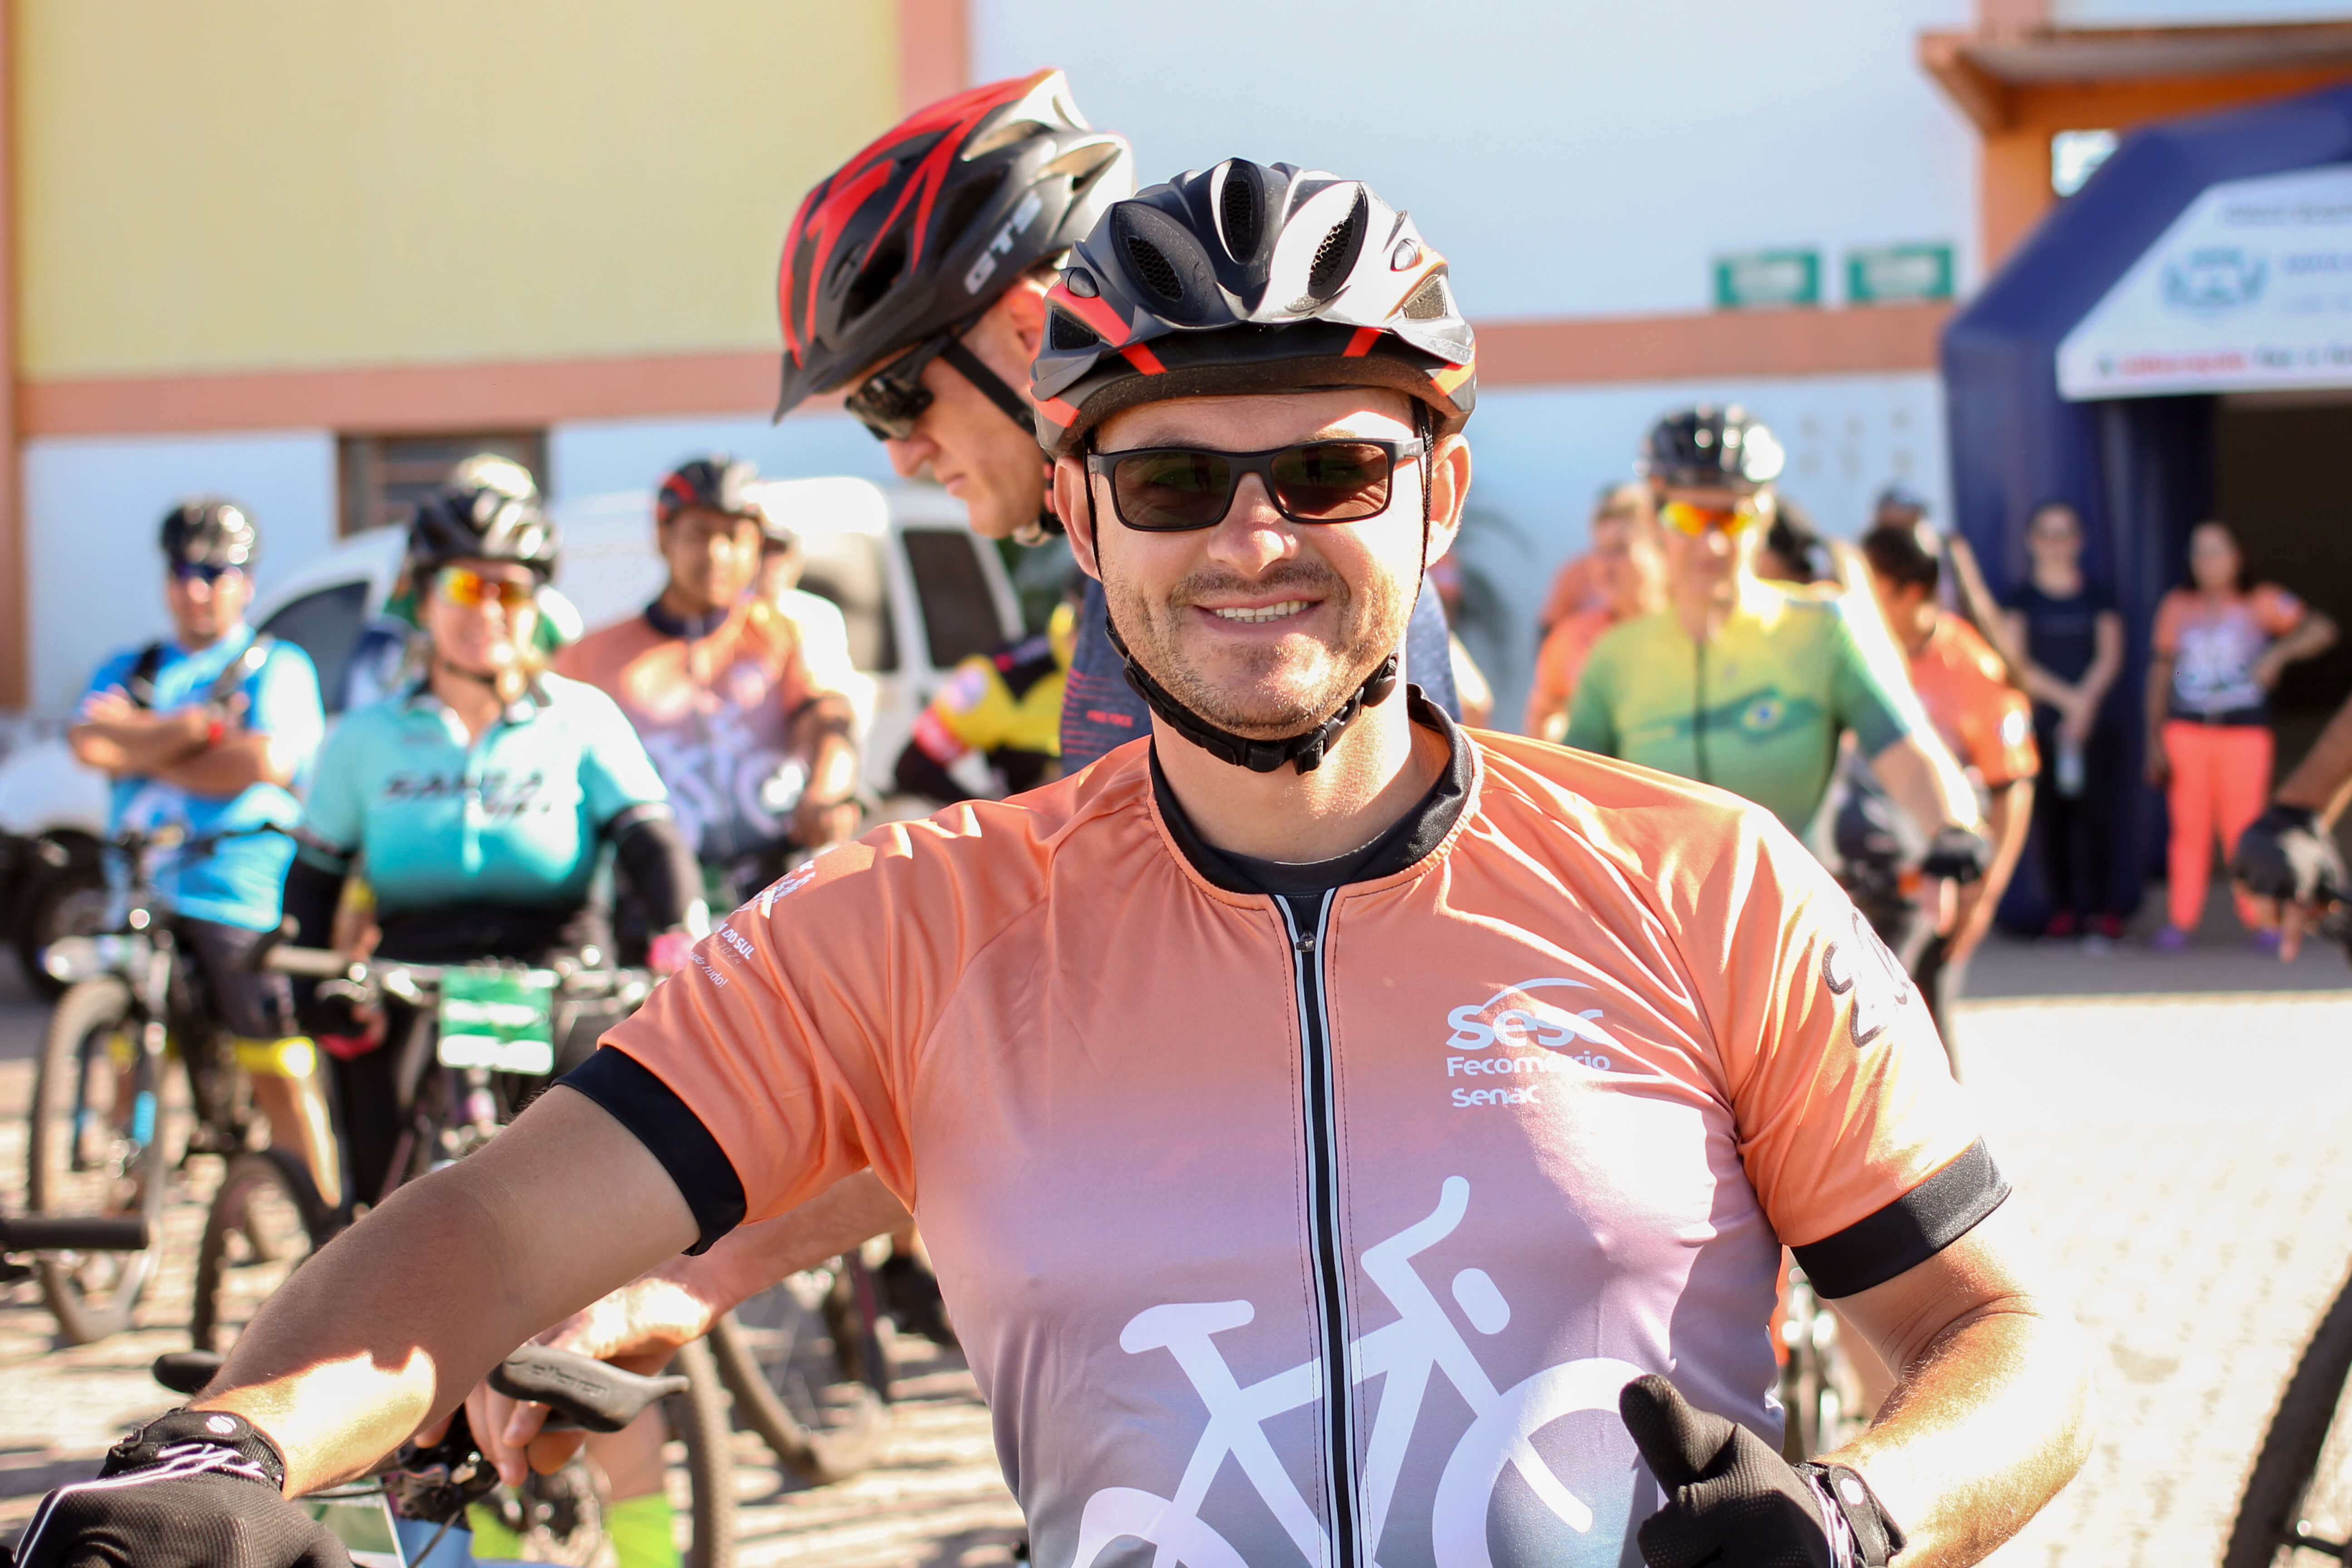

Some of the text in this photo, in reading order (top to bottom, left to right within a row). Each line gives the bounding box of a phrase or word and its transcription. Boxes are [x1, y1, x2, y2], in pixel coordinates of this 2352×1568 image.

[964, 191, 1043, 296] GTS
[721, 928, 738, 943] DO
[733, 937, 755, 960] SUL
[1446, 1050, 1611, 1077] Fecomécio
